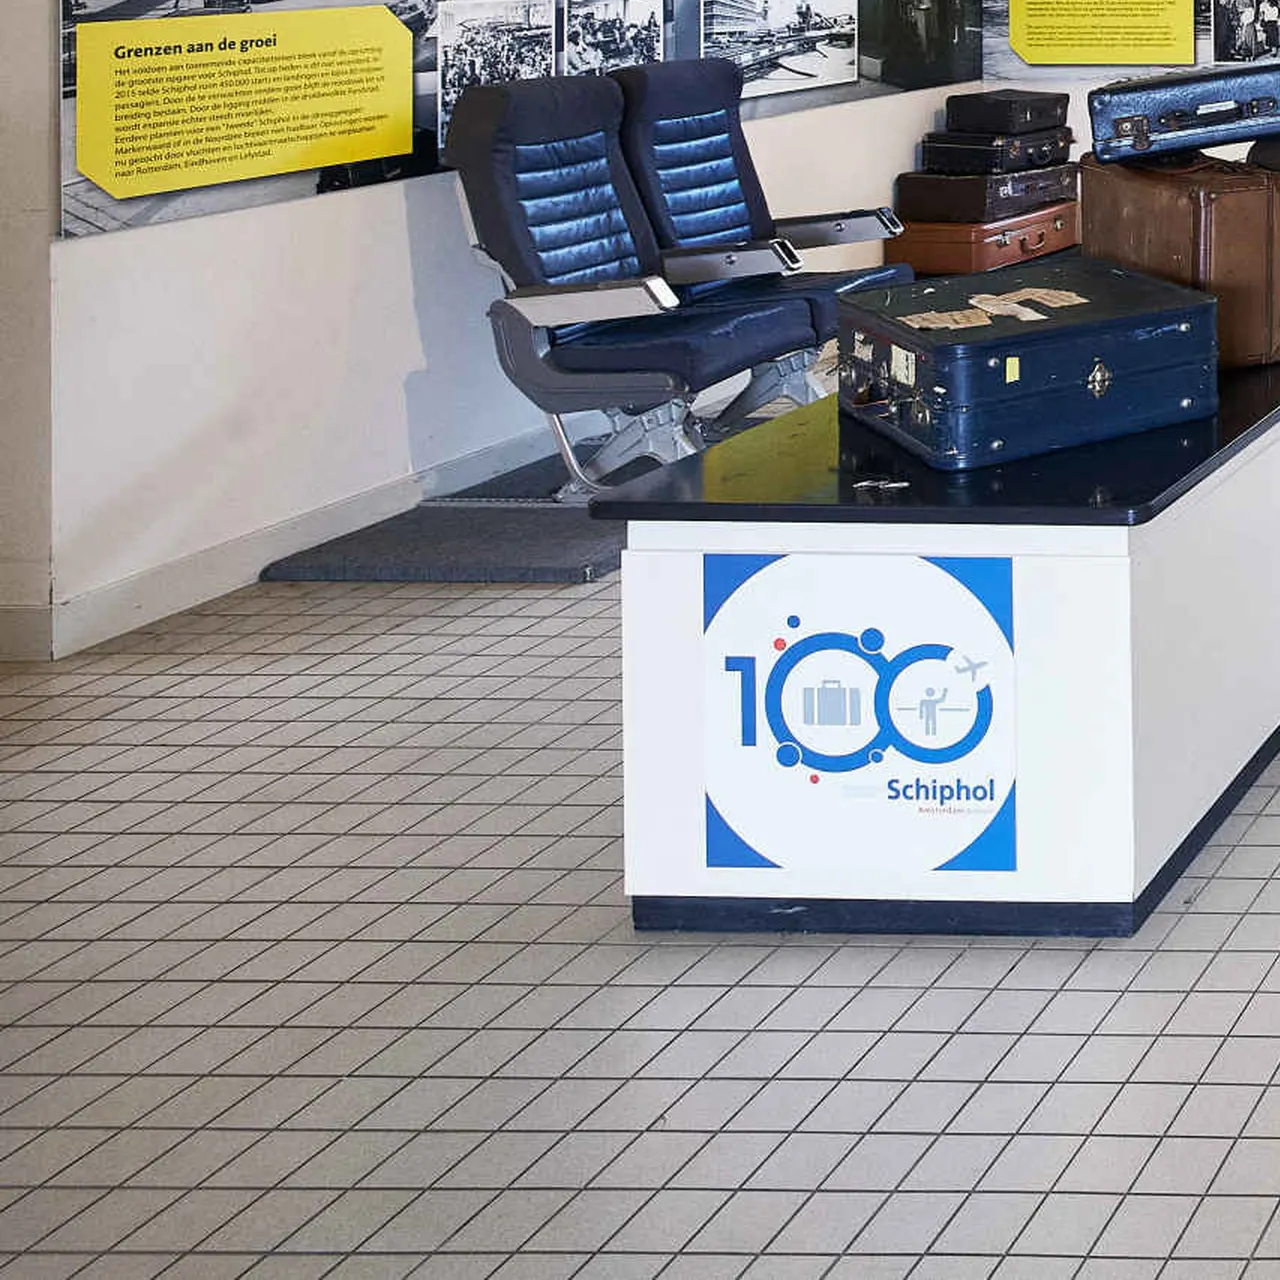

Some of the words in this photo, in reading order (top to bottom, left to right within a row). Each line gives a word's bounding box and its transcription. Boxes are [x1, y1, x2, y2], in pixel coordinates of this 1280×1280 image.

[114, 45, 183, 59] Grenzen
[186, 41, 214, 54] aan
[217, 36, 237, 51] de
[239, 33, 277, 53] groei
[725, 626, 994, 773] 100
[887, 777, 995, 806] Schiphol
